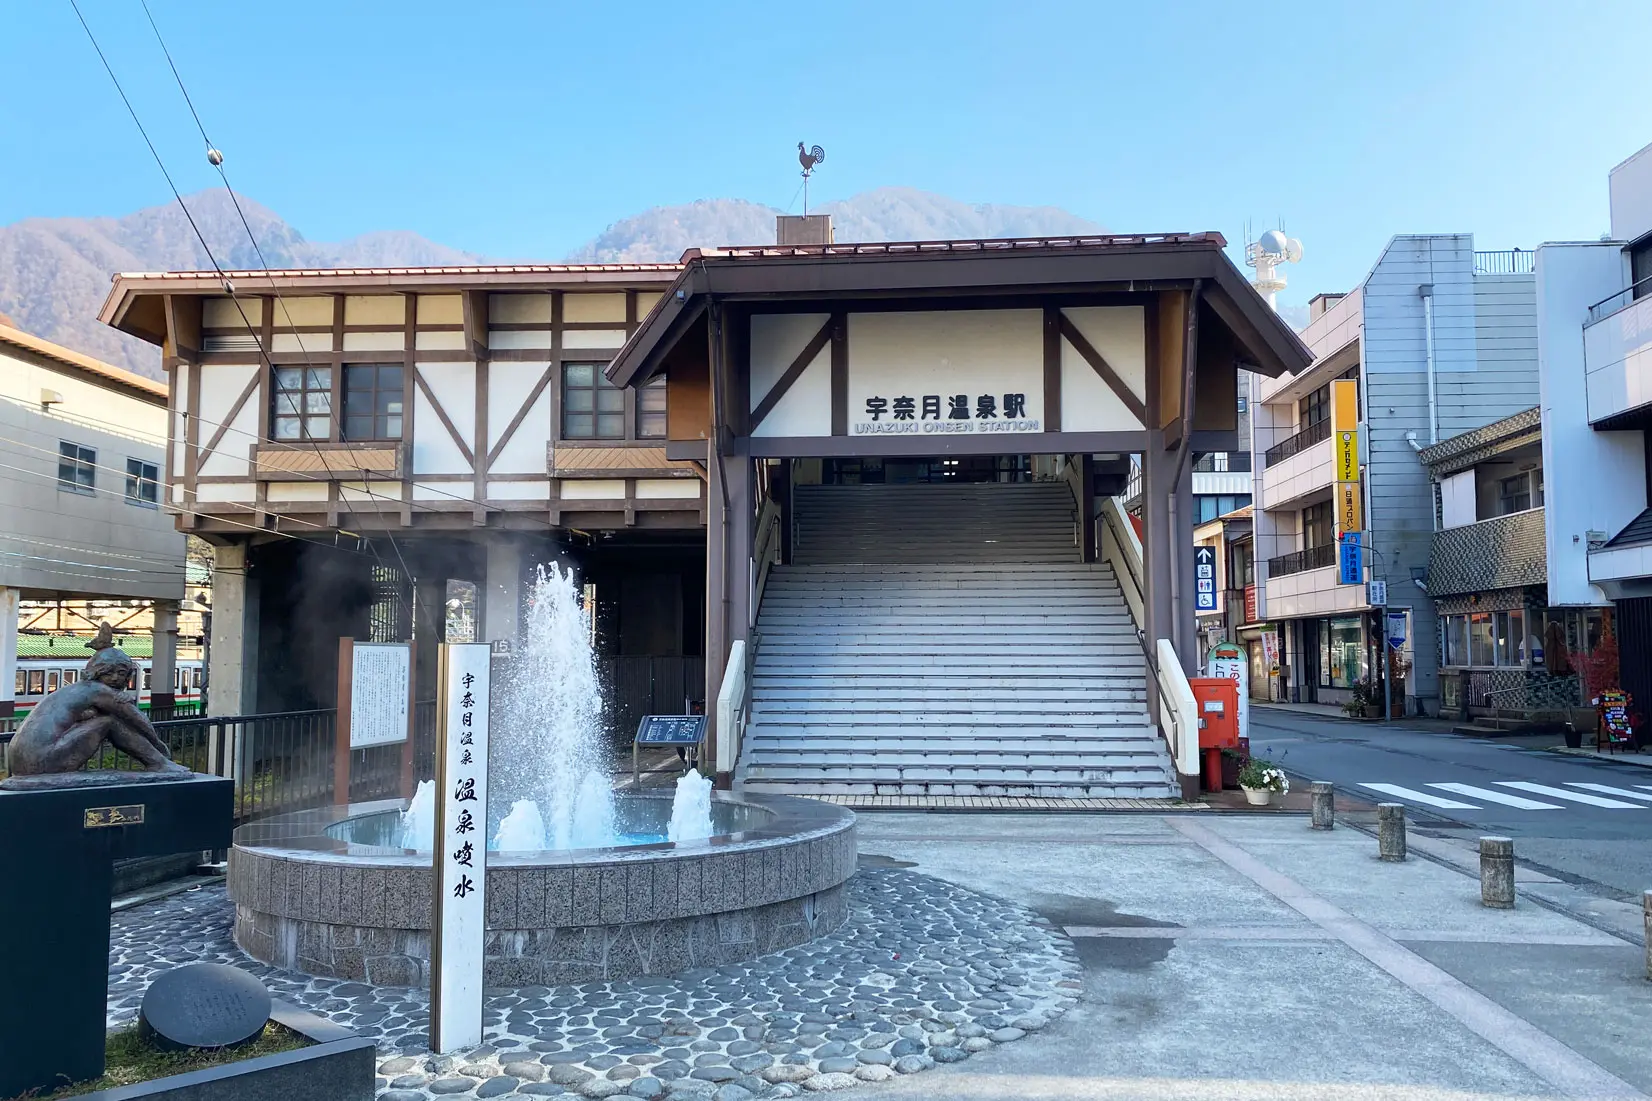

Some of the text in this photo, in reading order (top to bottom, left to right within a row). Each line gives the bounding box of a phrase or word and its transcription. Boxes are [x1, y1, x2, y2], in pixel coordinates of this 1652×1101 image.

[866, 394, 1026, 421] 宇奈月温泉駅
[855, 420, 1039, 434] UNAZUKI ONSEN STATION
[494, 640, 508, 652] 15
[453, 672, 478, 899] 宇奈月温泉 温泉噴水
